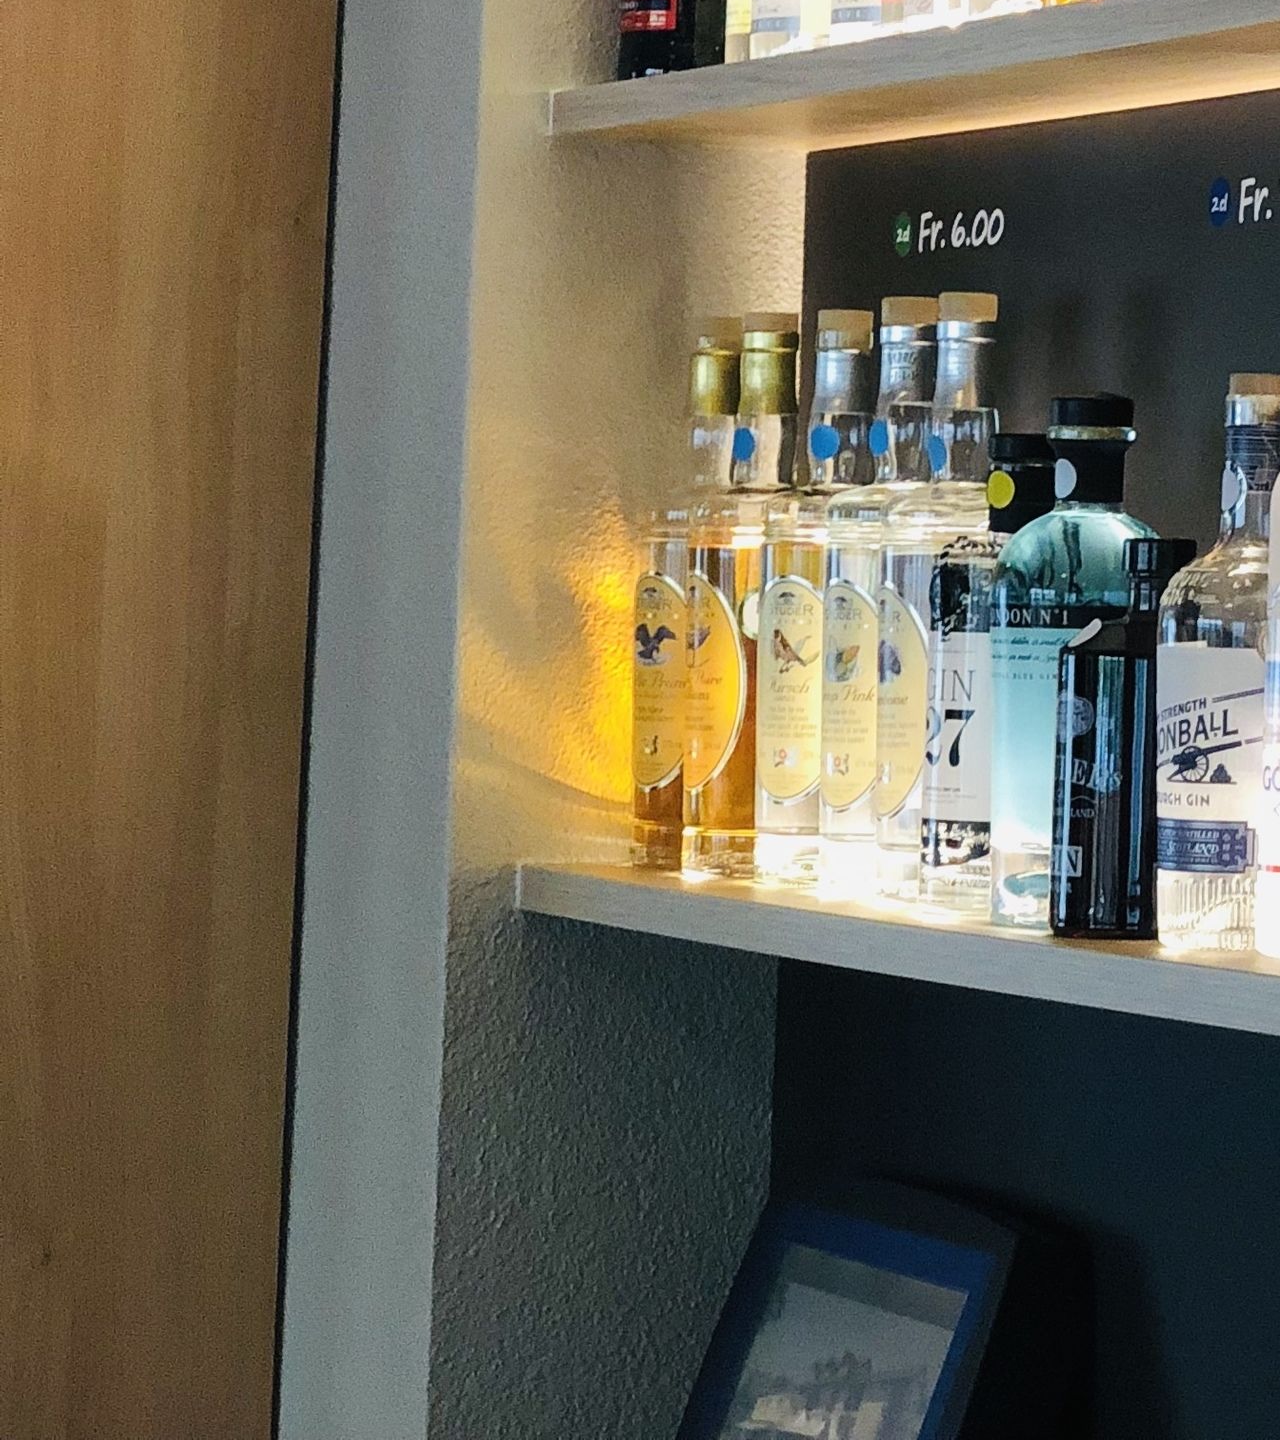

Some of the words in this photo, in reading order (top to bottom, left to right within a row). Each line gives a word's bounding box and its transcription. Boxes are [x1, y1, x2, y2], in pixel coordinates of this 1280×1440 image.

[1238, 177, 1273, 224] Fr.
[918, 211, 946, 253] Fr.
[951, 208, 1005, 248] 6.00
[842, 684, 876, 703] Pink
[927, 667, 976, 702] GIN
[1161, 697, 1207, 722] STRENGTH
[925, 706, 976, 768] 27
[1186, 793, 1211, 807] GIN
